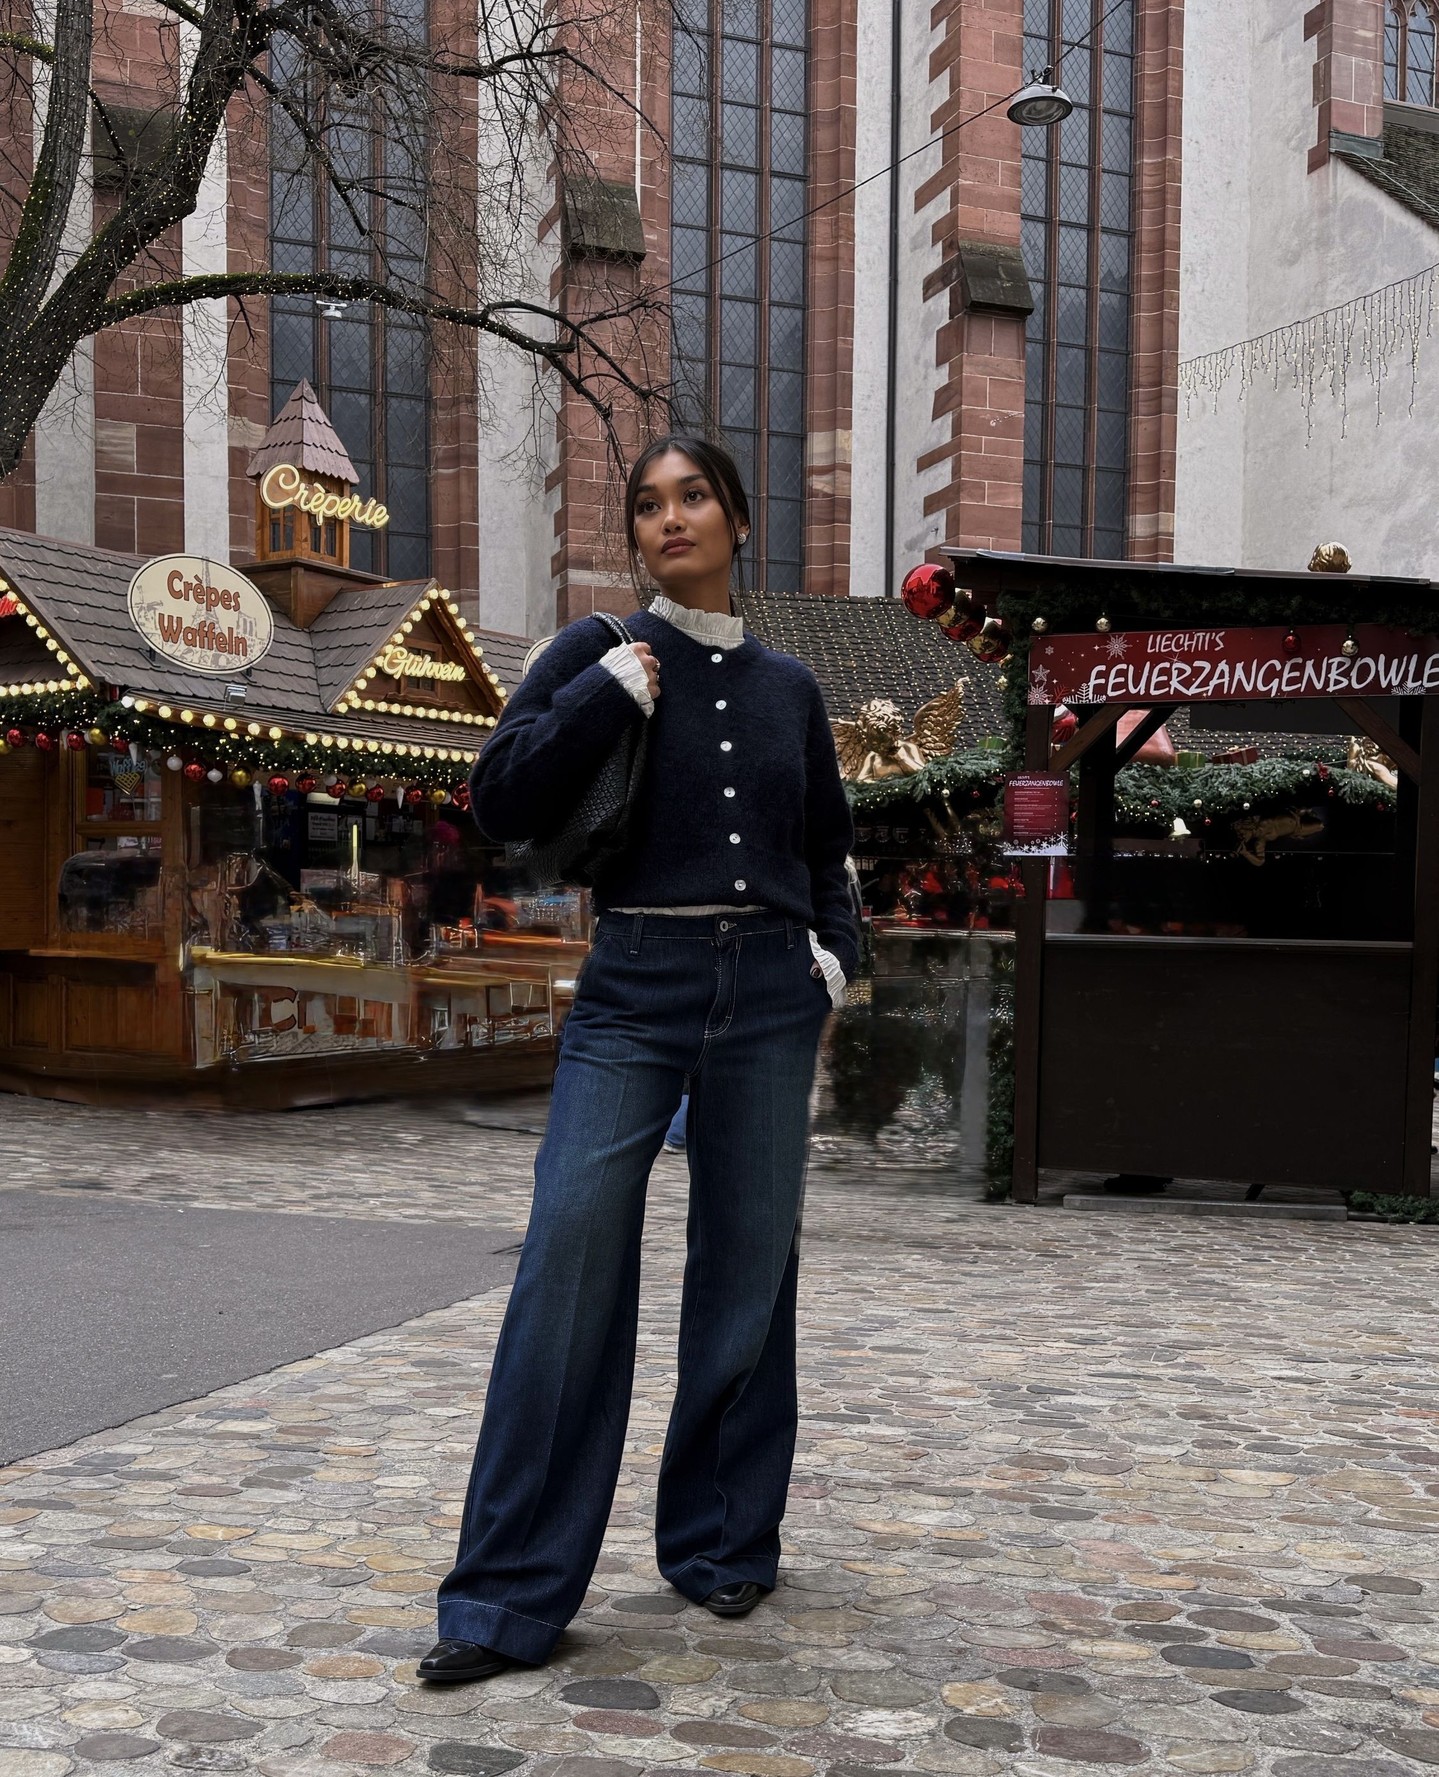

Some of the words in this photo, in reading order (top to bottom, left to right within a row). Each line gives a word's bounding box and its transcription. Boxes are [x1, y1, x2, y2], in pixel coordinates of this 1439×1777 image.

[167, 569, 241, 612] Crèpes
[158, 613, 248, 657] Waffeln
[1147, 631, 1226, 654] LIECHTI'S
[382, 646, 466, 682] Glühwein
[1088, 653, 1439, 700] FEUERZANGENBOWLE
